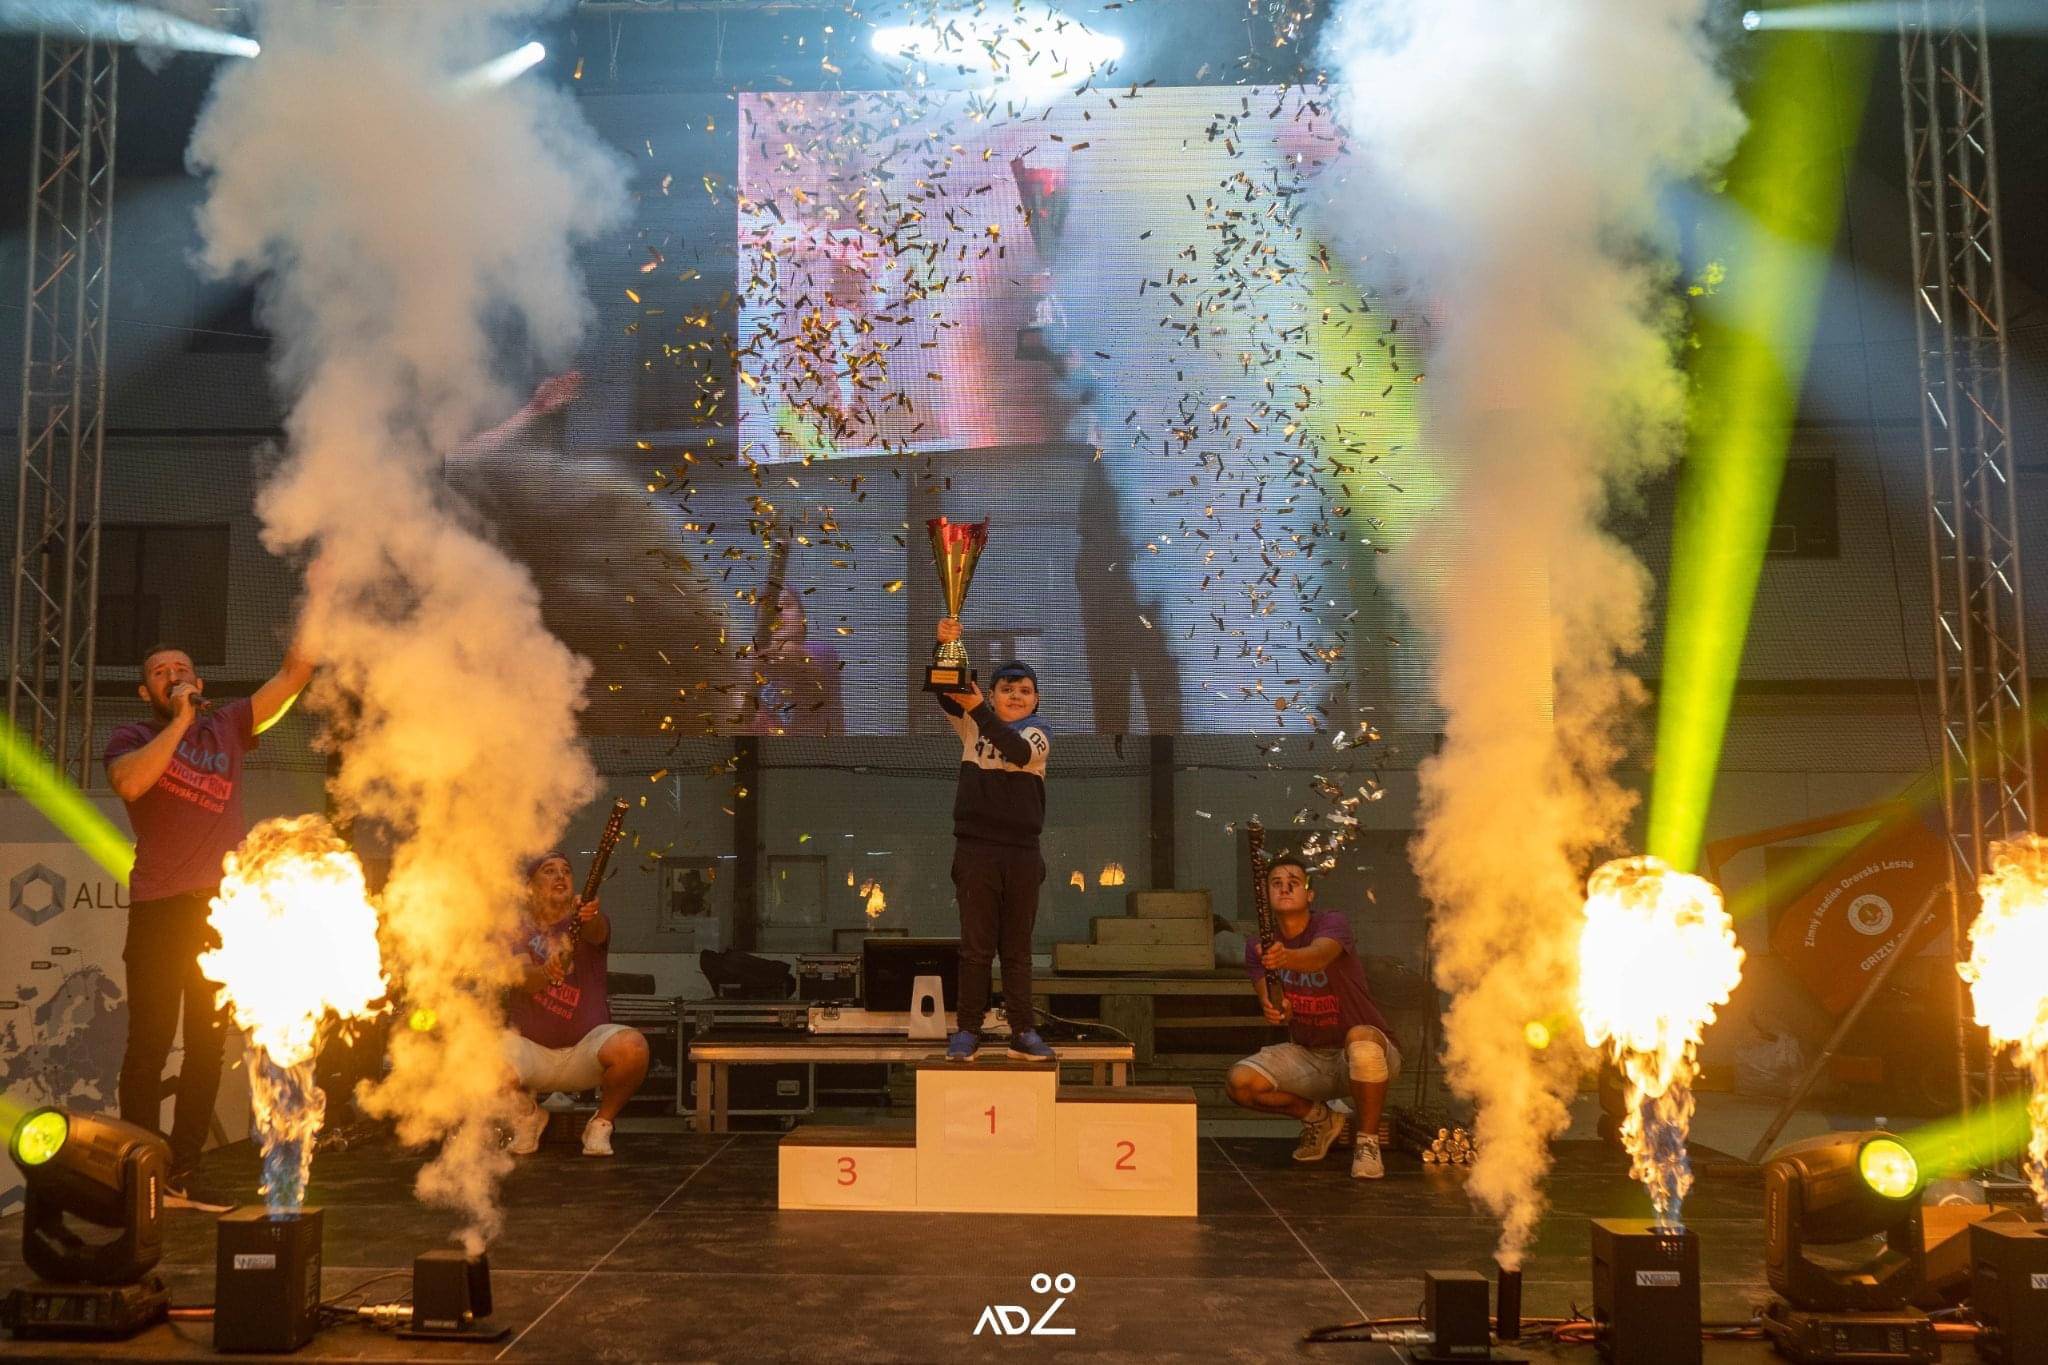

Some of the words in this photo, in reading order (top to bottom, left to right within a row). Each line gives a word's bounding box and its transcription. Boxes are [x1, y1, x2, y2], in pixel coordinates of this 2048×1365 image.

[177, 740, 229, 773] LUKO
[1030, 732, 1047, 756] 02
[1840, 862, 1881, 889] Oravská
[1882, 859, 1914, 870] Lesná
[984, 1105, 996, 1134] 1
[1114, 1140, 1137, 1171] 2
[836, 1156, 858, 1186] 3
